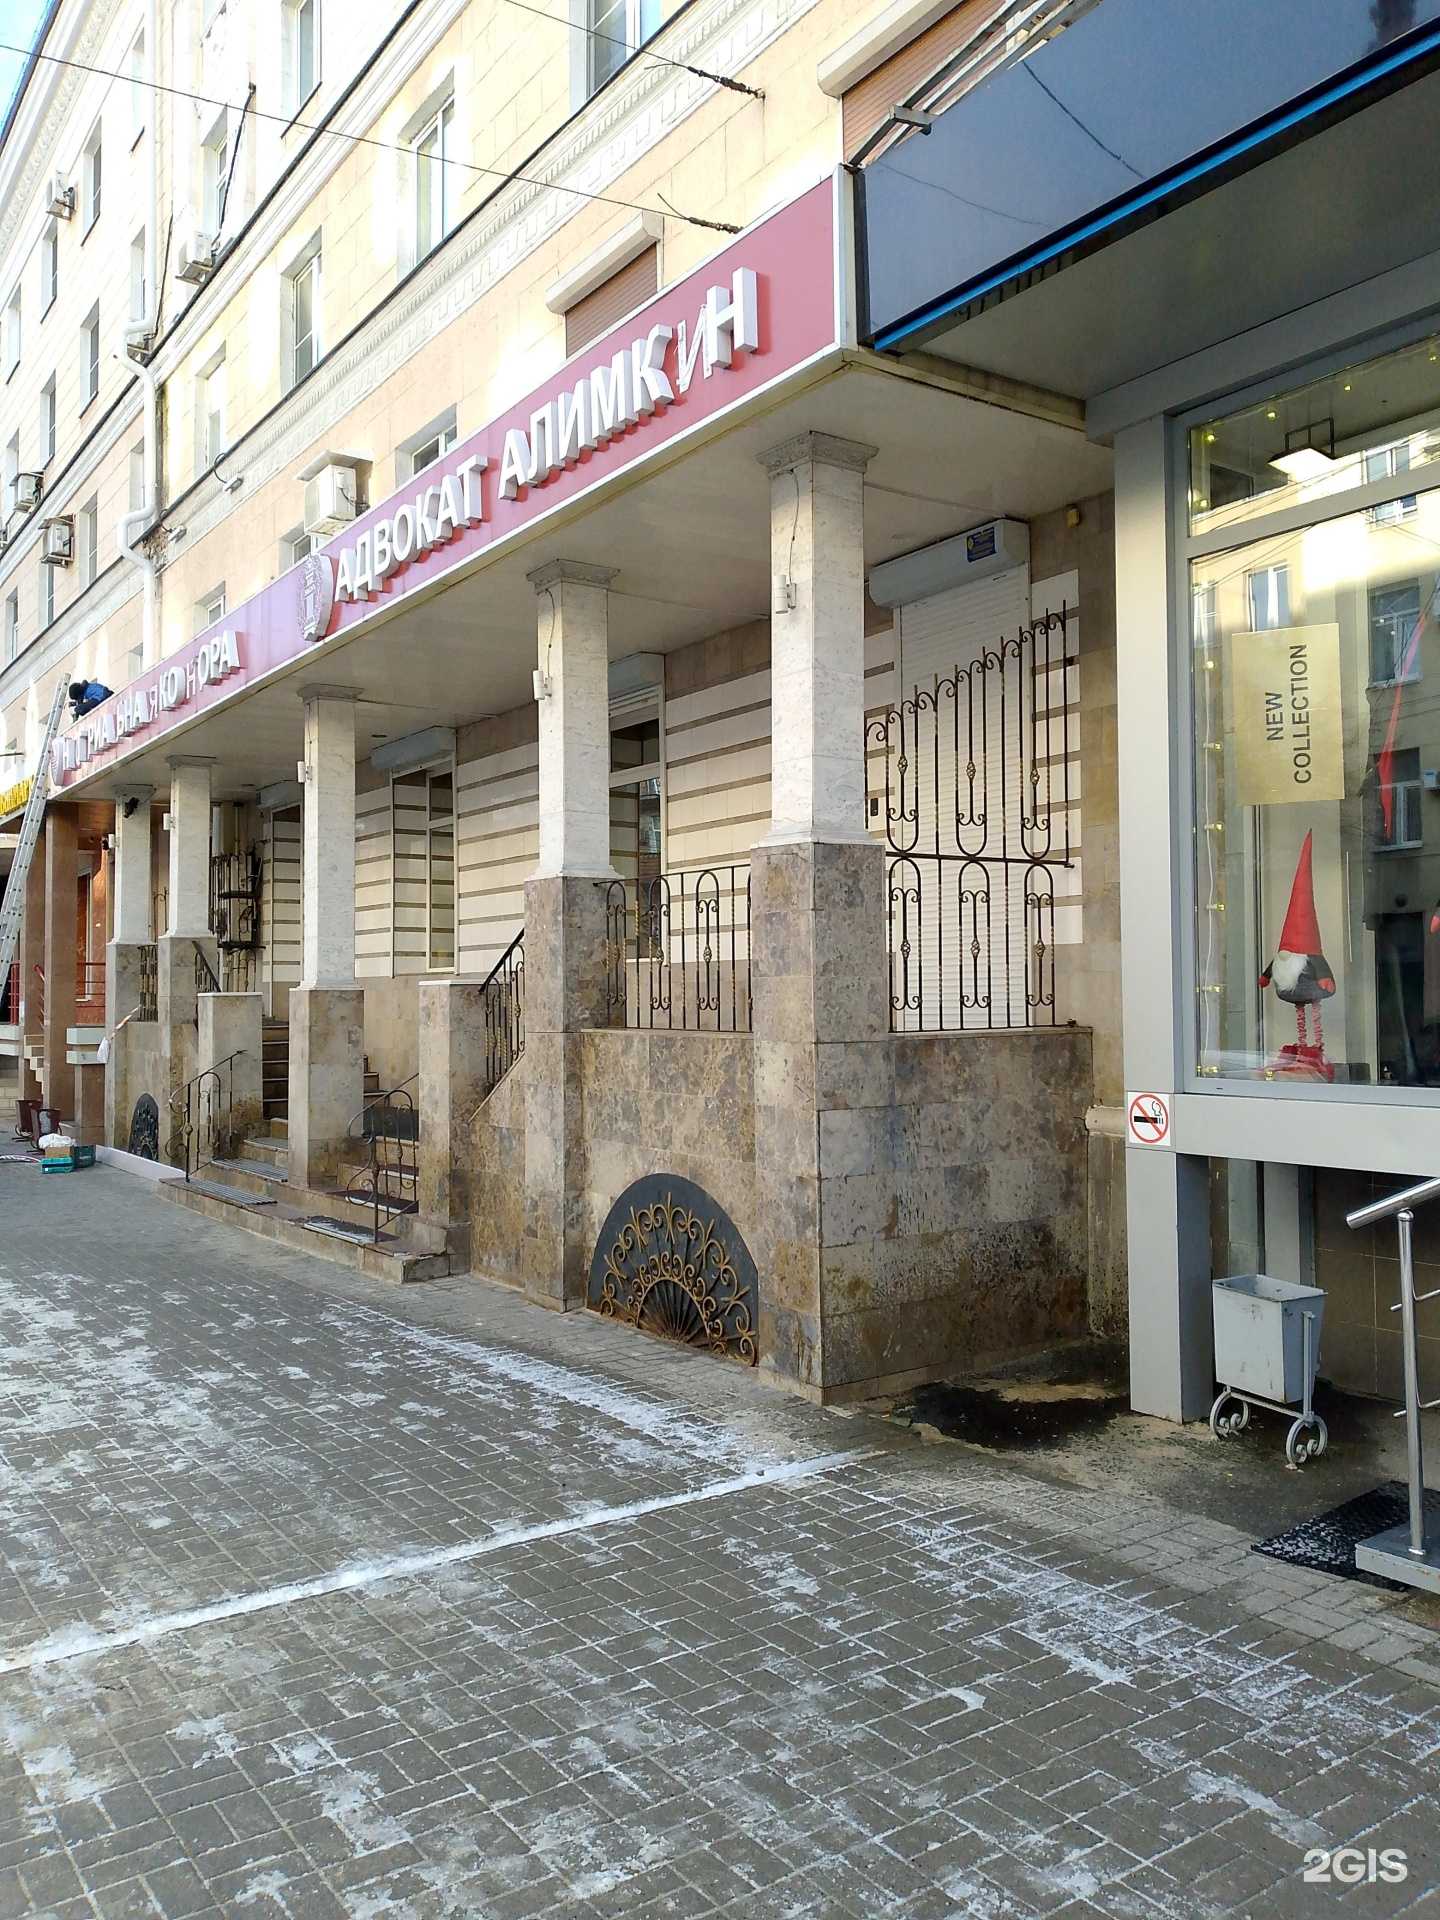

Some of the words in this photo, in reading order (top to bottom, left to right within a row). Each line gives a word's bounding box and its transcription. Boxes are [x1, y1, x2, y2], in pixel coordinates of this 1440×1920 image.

[334, 454, 488, 602] АДВОКАТ
[498, 266, 759, 501] АЛИМКИН
[62, 685, 158, 771] НТРИАЬНАЯ
[1264, 692, 1284, 741] NEW
[1289, 644, 1312, 784] COLLECTION
